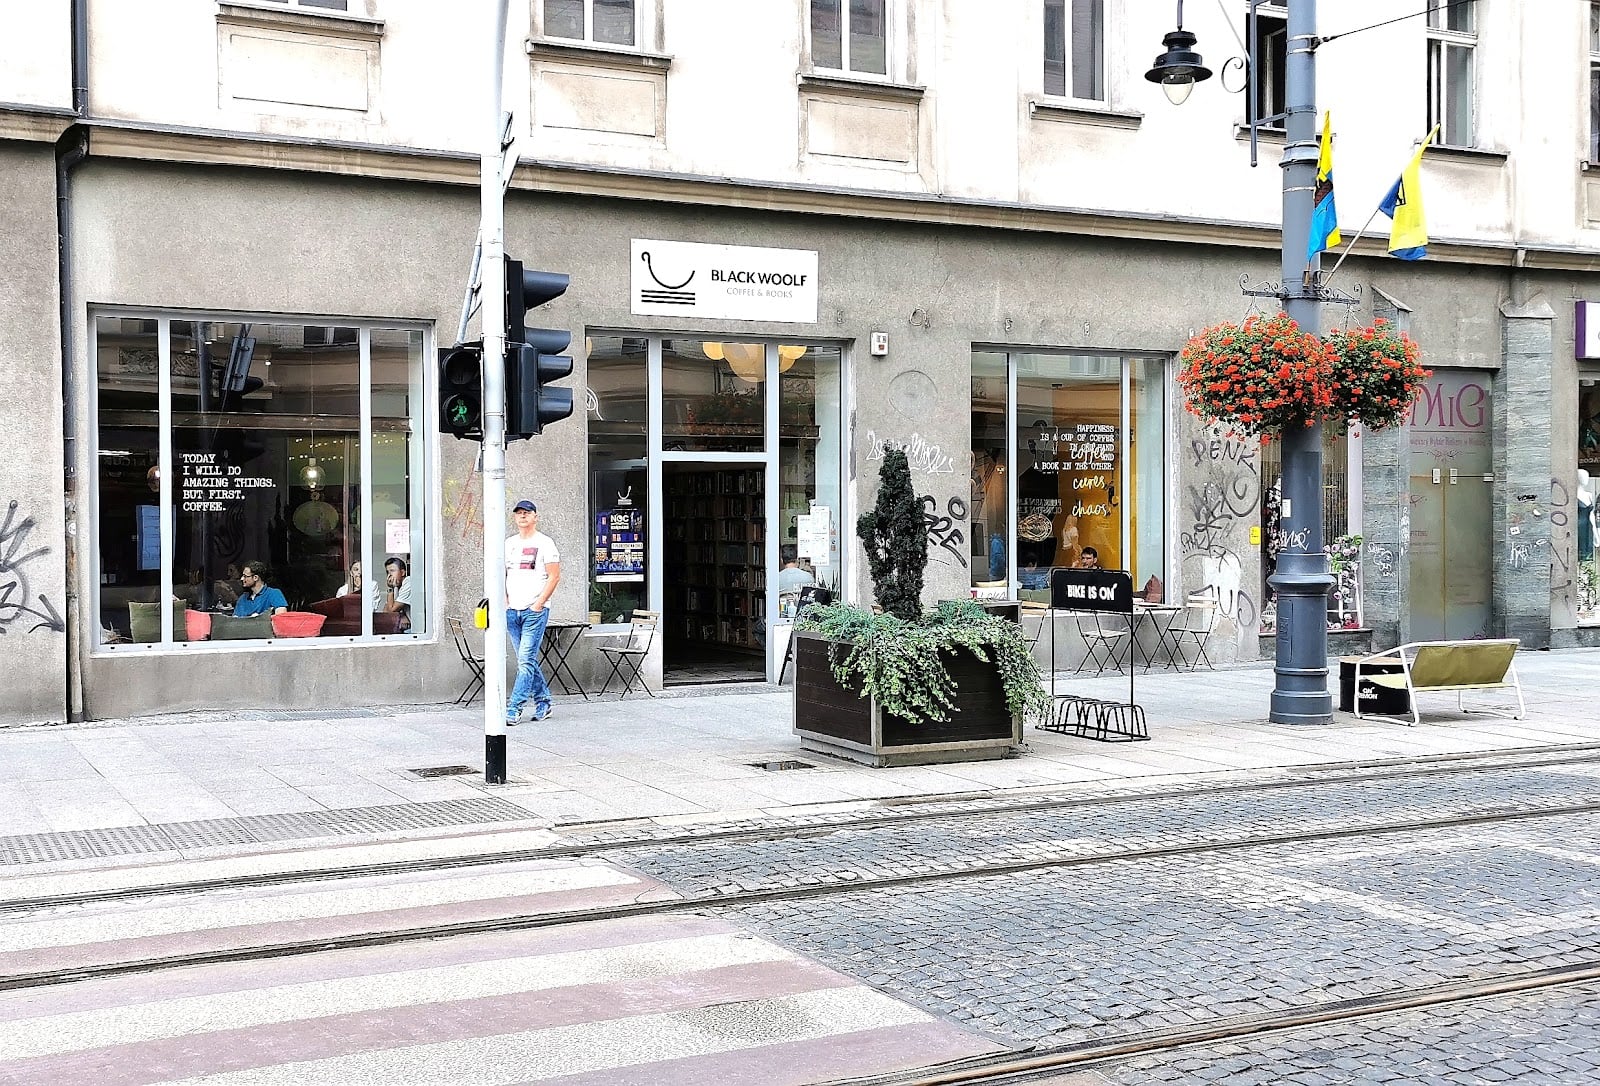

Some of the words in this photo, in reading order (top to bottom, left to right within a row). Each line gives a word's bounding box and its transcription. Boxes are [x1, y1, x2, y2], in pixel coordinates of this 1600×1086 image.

[711, 269, 756, 284] BLACK
[757, 272, 807, 287] WOOLF
[726, 287, 755, 297] COFFEE
[757, 288, 763, 297] &
[765, 289, 793, 299] BOOKS
[1077, 424, 1115, 433] HAPPINESS
[1040, 433, 1050, 441] IS
[1060, 433, 1074, 441] CUP
[1089, 434, 1115, 442] COFFEE
[1069, 443, 1078, 451] IN
[182, 453, 216, 463] TODAY
[182, 465, 190, 475] I
[195, 465, 222, 475] WILL
[227, 465, 241, 475] DO
[1033, 462, 1039, 470] A
[1041, 462, 1060, 470] BOOK
[1062, 462, 1072, 470] IN
[1075, 462, 1088, 470] THE
[1091, 462, 1114, 470] OTHER.
[182, 478, 229, 487] AMAZING
[234, 478, 276, 487] THINGS.
[182, 490, 203, 499] BUT
[208, 490, 245, 500] FIRST.
[182, 502, 226, 511] COFFEE.
[610, 514, 629, 523] NOC
[1067, 584, 1086, 598] BIKE
[1088, 585, 1097, 599] IS
[1099, 584, 1116, 600] ON
[1358, 692, 1378, 700] EMON
